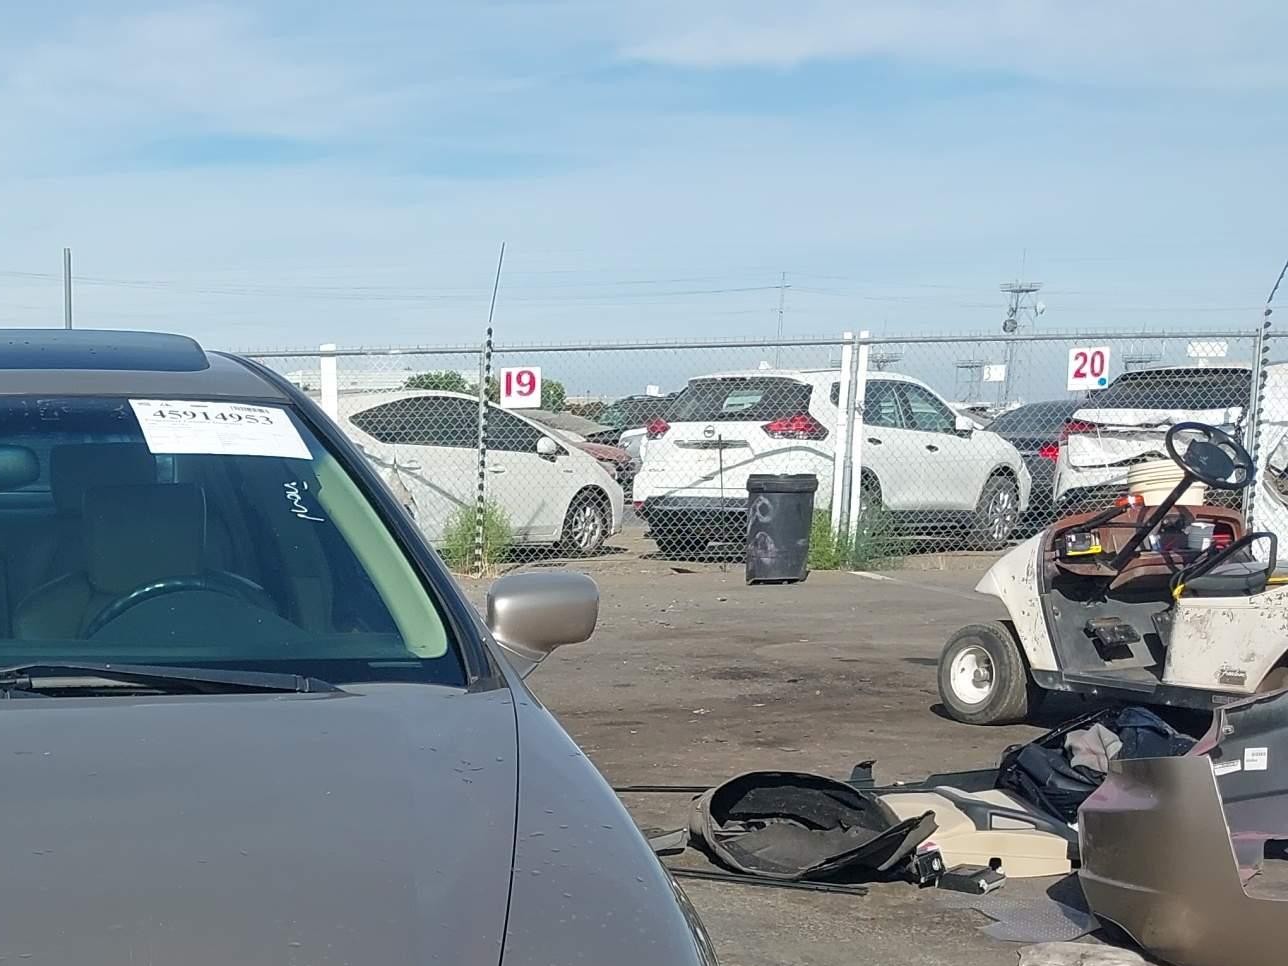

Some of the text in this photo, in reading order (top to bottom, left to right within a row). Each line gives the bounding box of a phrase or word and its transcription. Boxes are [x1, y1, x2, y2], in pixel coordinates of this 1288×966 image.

[1072, 350, 1105, 379] 20
[505, 369, 536, 397] 19
[153, 408, 274, 426] 45914953
